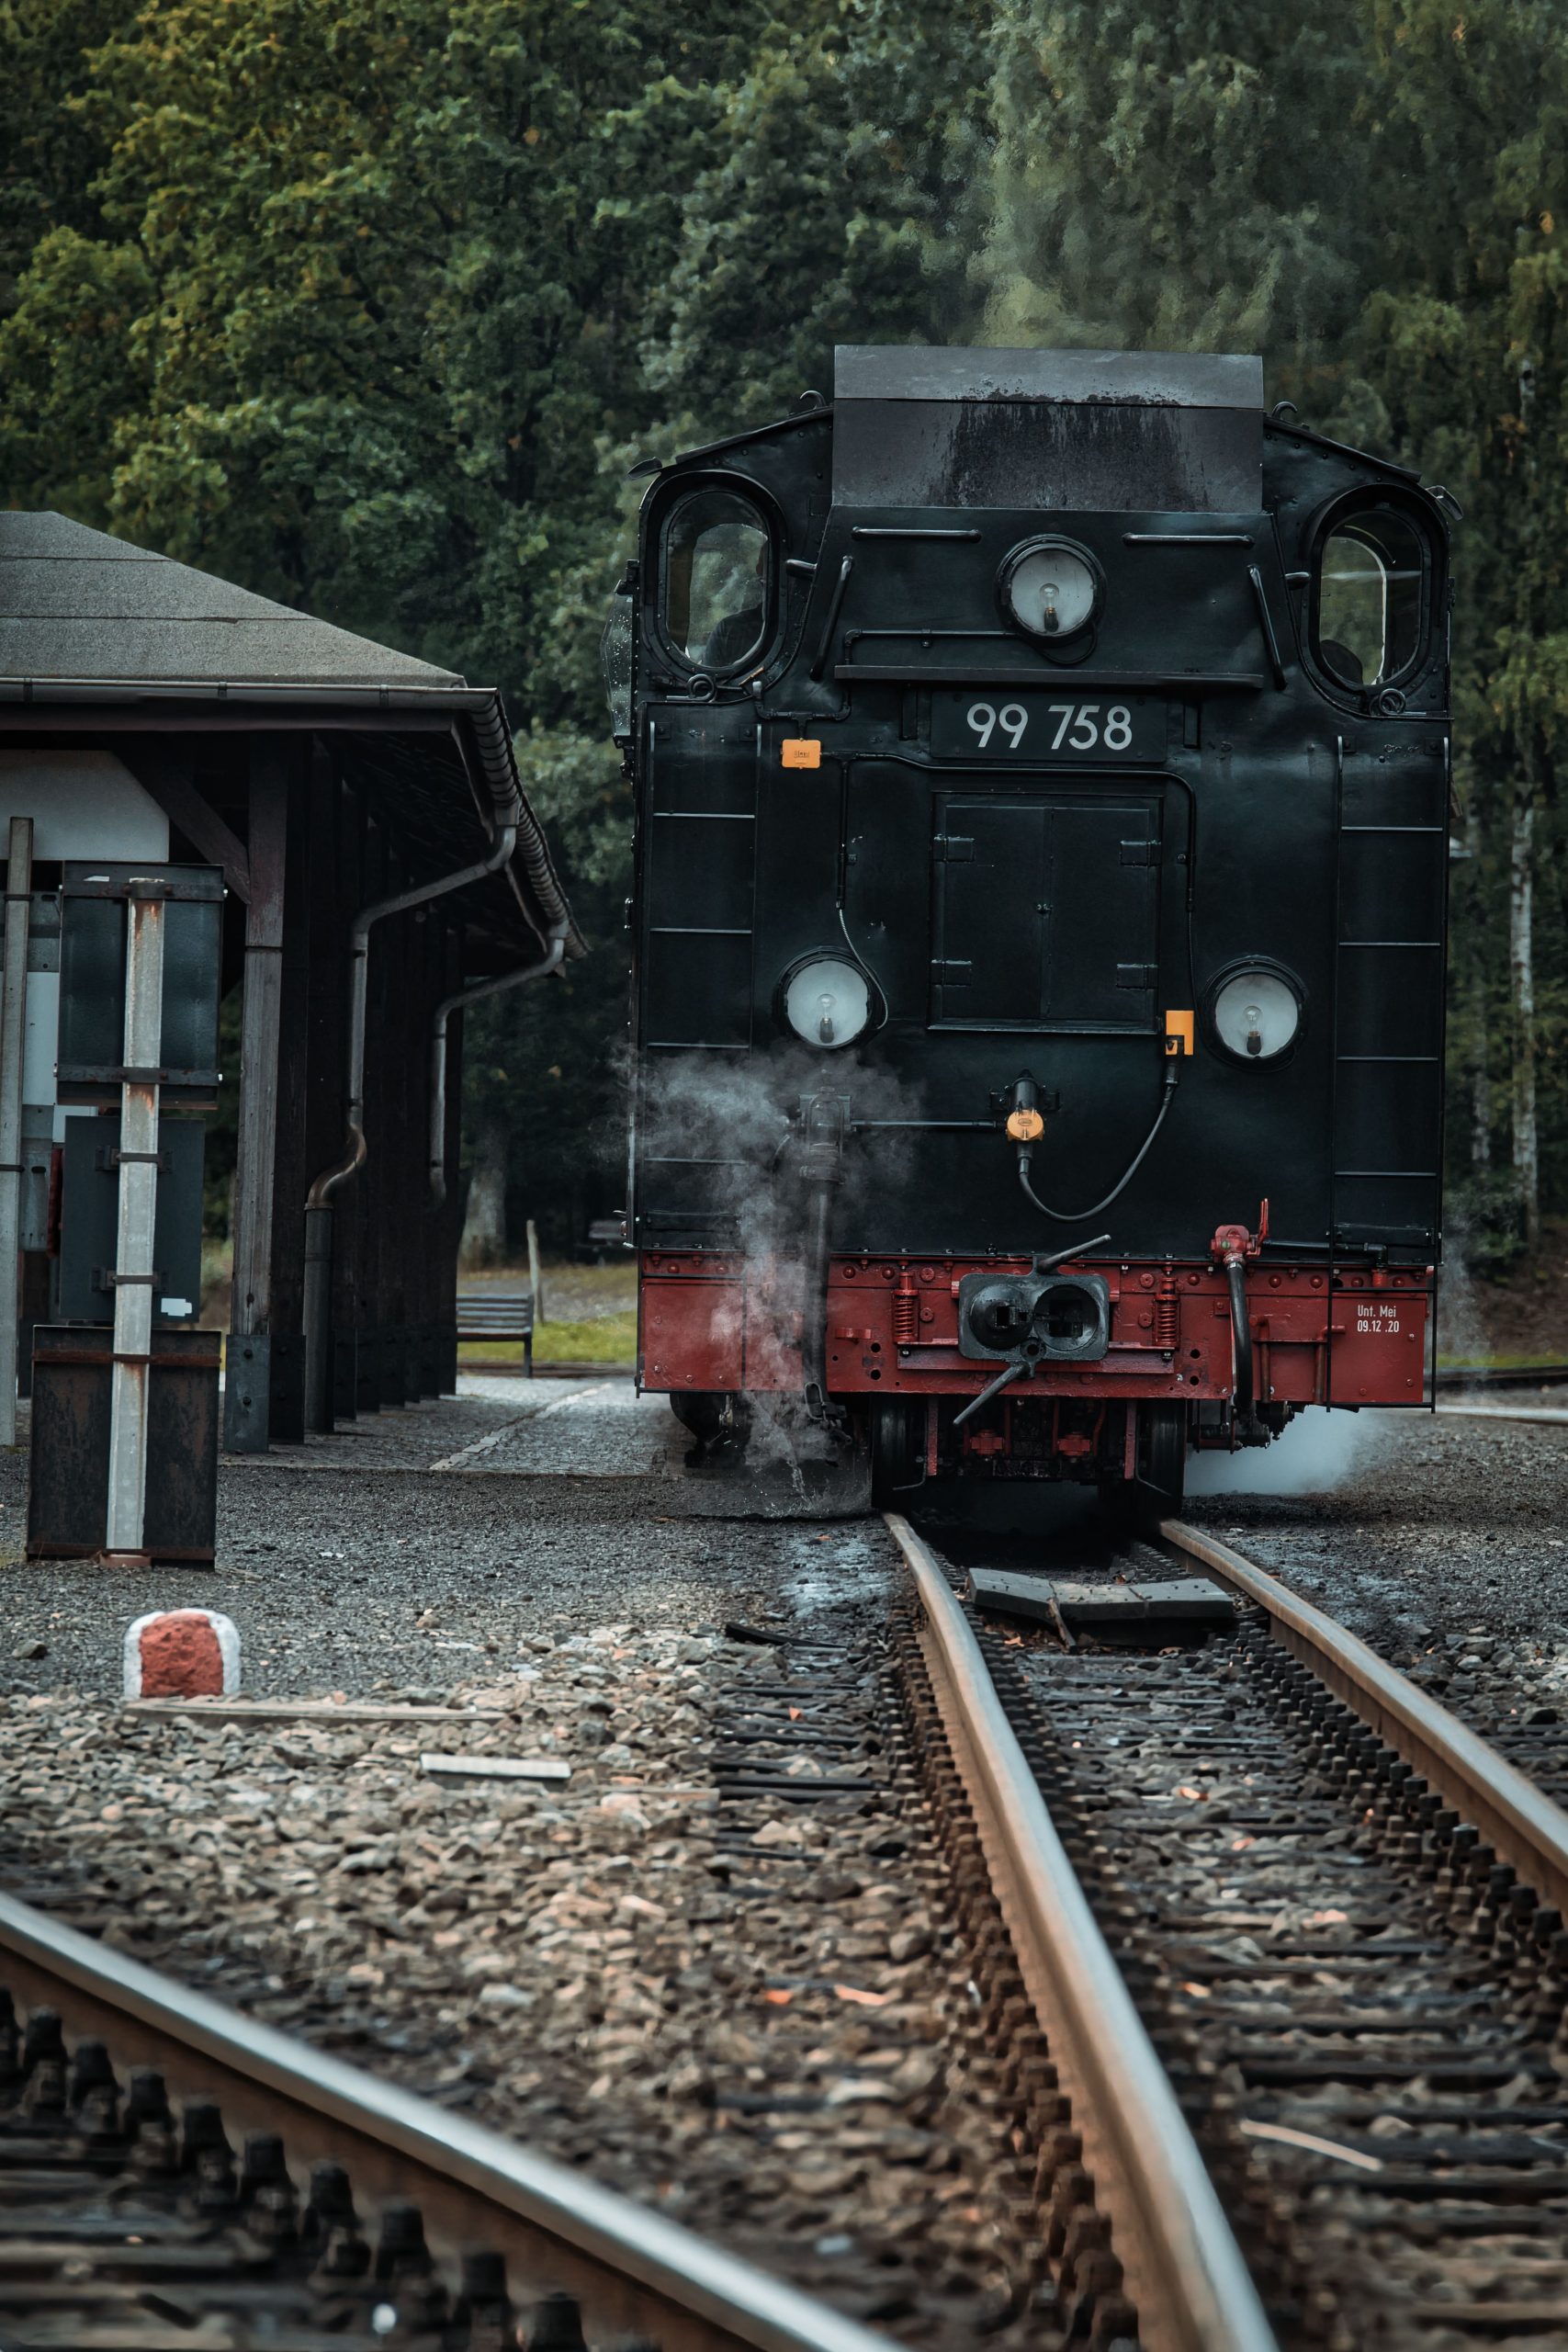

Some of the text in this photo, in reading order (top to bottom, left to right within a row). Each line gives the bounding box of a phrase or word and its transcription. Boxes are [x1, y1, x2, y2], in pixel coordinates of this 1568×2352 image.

[966, 702, 1133, 751] 99 758
[1357, 1305, 1396, 1317] Unt. Mei
[1357, 1319, 1382, 1332] 09.12
